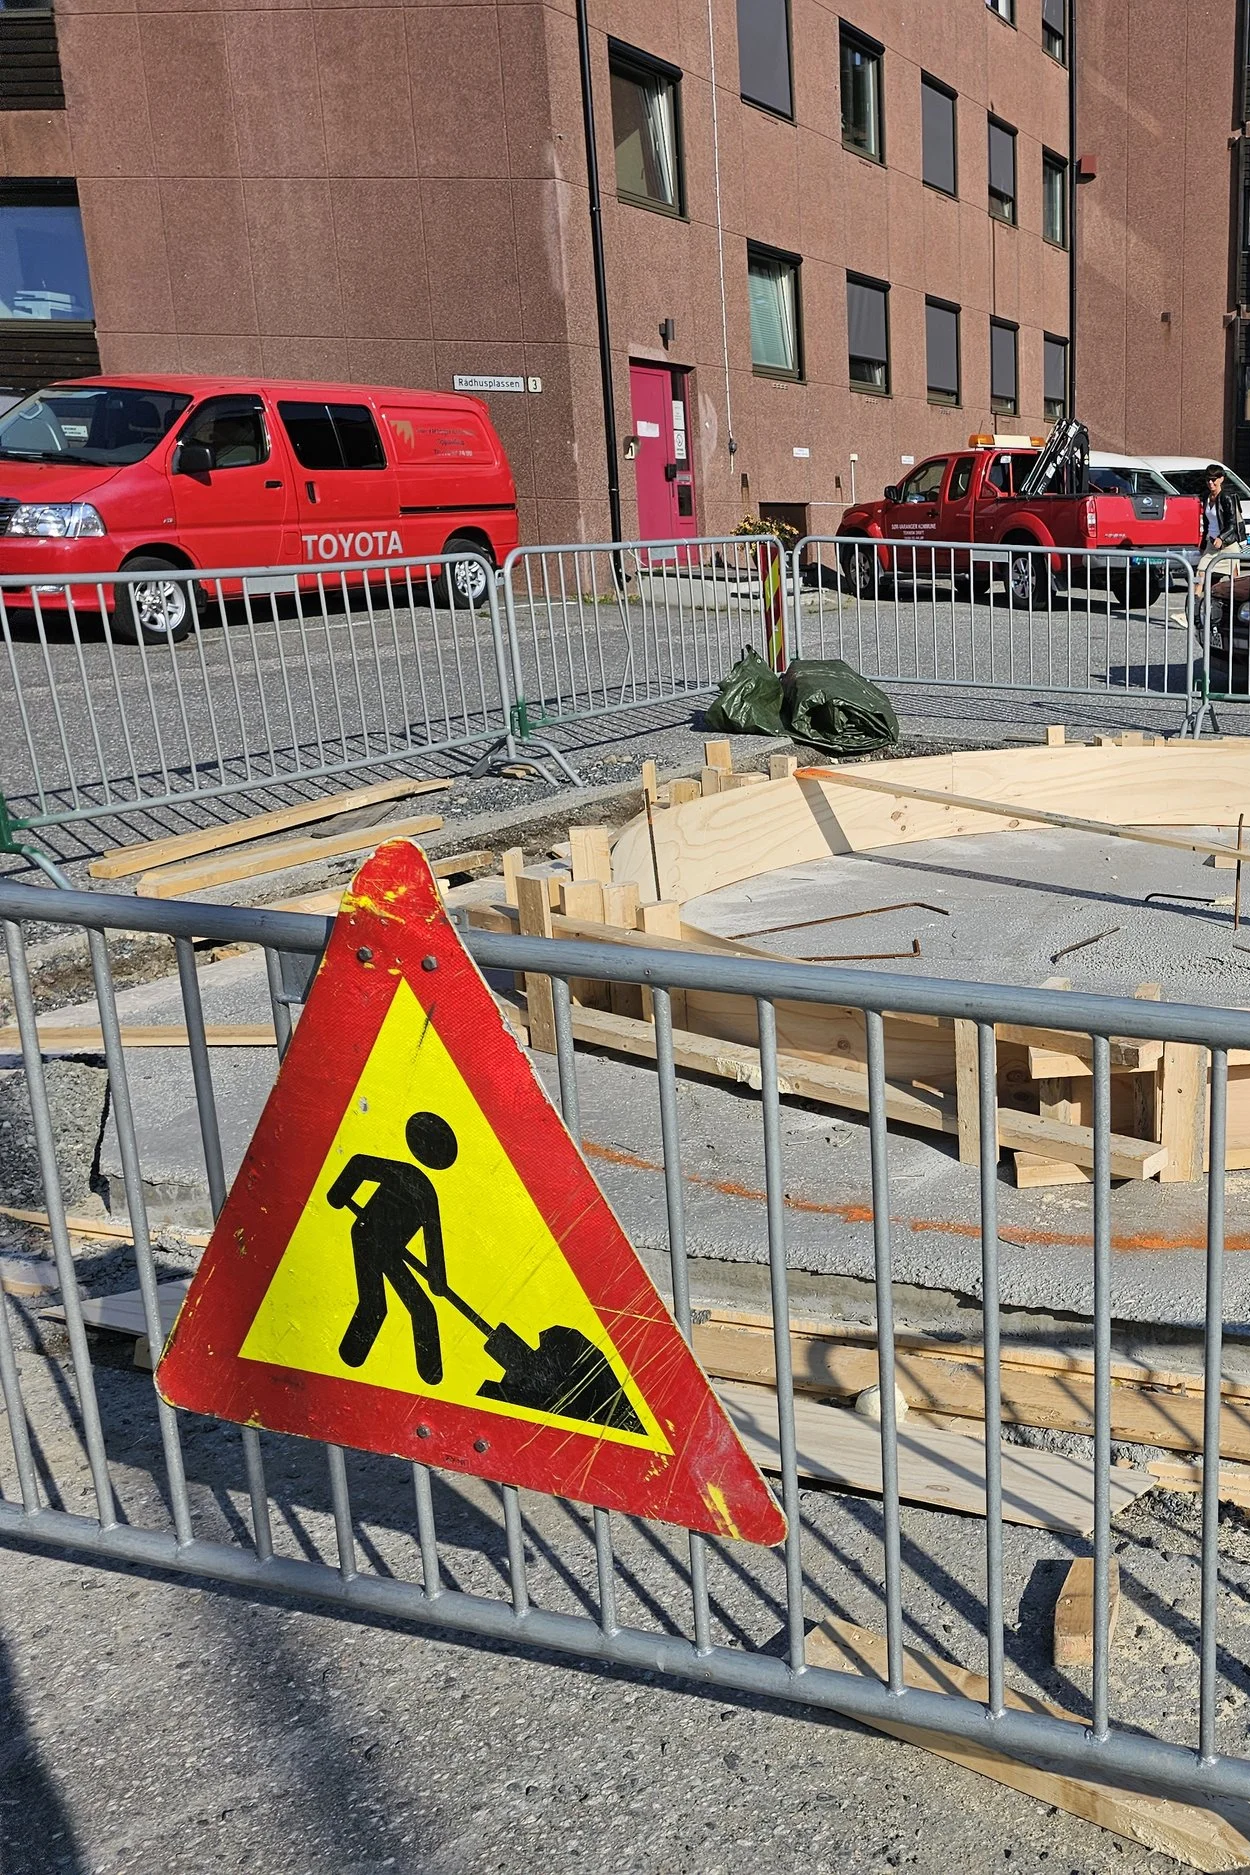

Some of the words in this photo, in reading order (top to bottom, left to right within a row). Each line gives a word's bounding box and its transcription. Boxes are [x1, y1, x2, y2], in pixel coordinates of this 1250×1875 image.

[458, 378, 520, 388] Rådhusplassen
[532, 379, 538, 390] 3
[302, 530, 404, 560] TOYOTA
